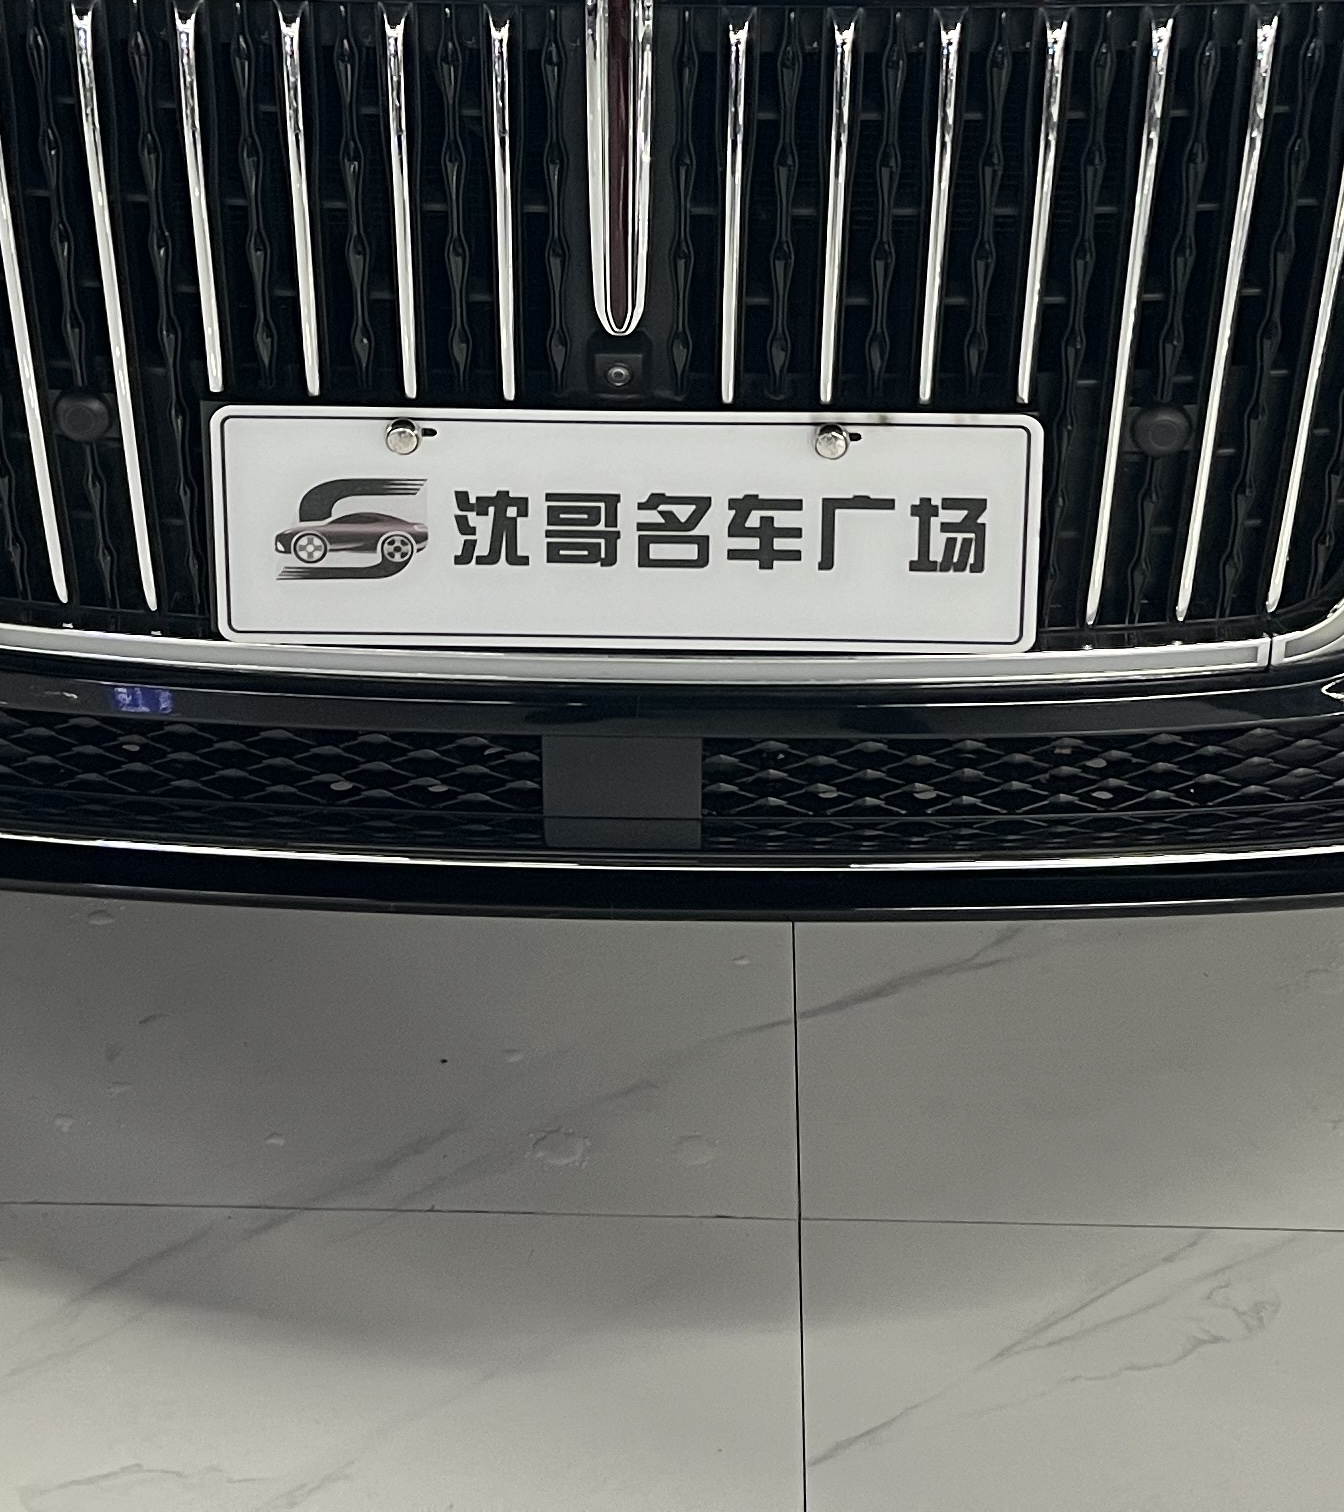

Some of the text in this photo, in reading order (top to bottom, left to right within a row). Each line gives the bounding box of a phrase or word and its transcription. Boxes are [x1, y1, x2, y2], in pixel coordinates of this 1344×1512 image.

[453, 489, 989, 575] 沈哥名车广场
